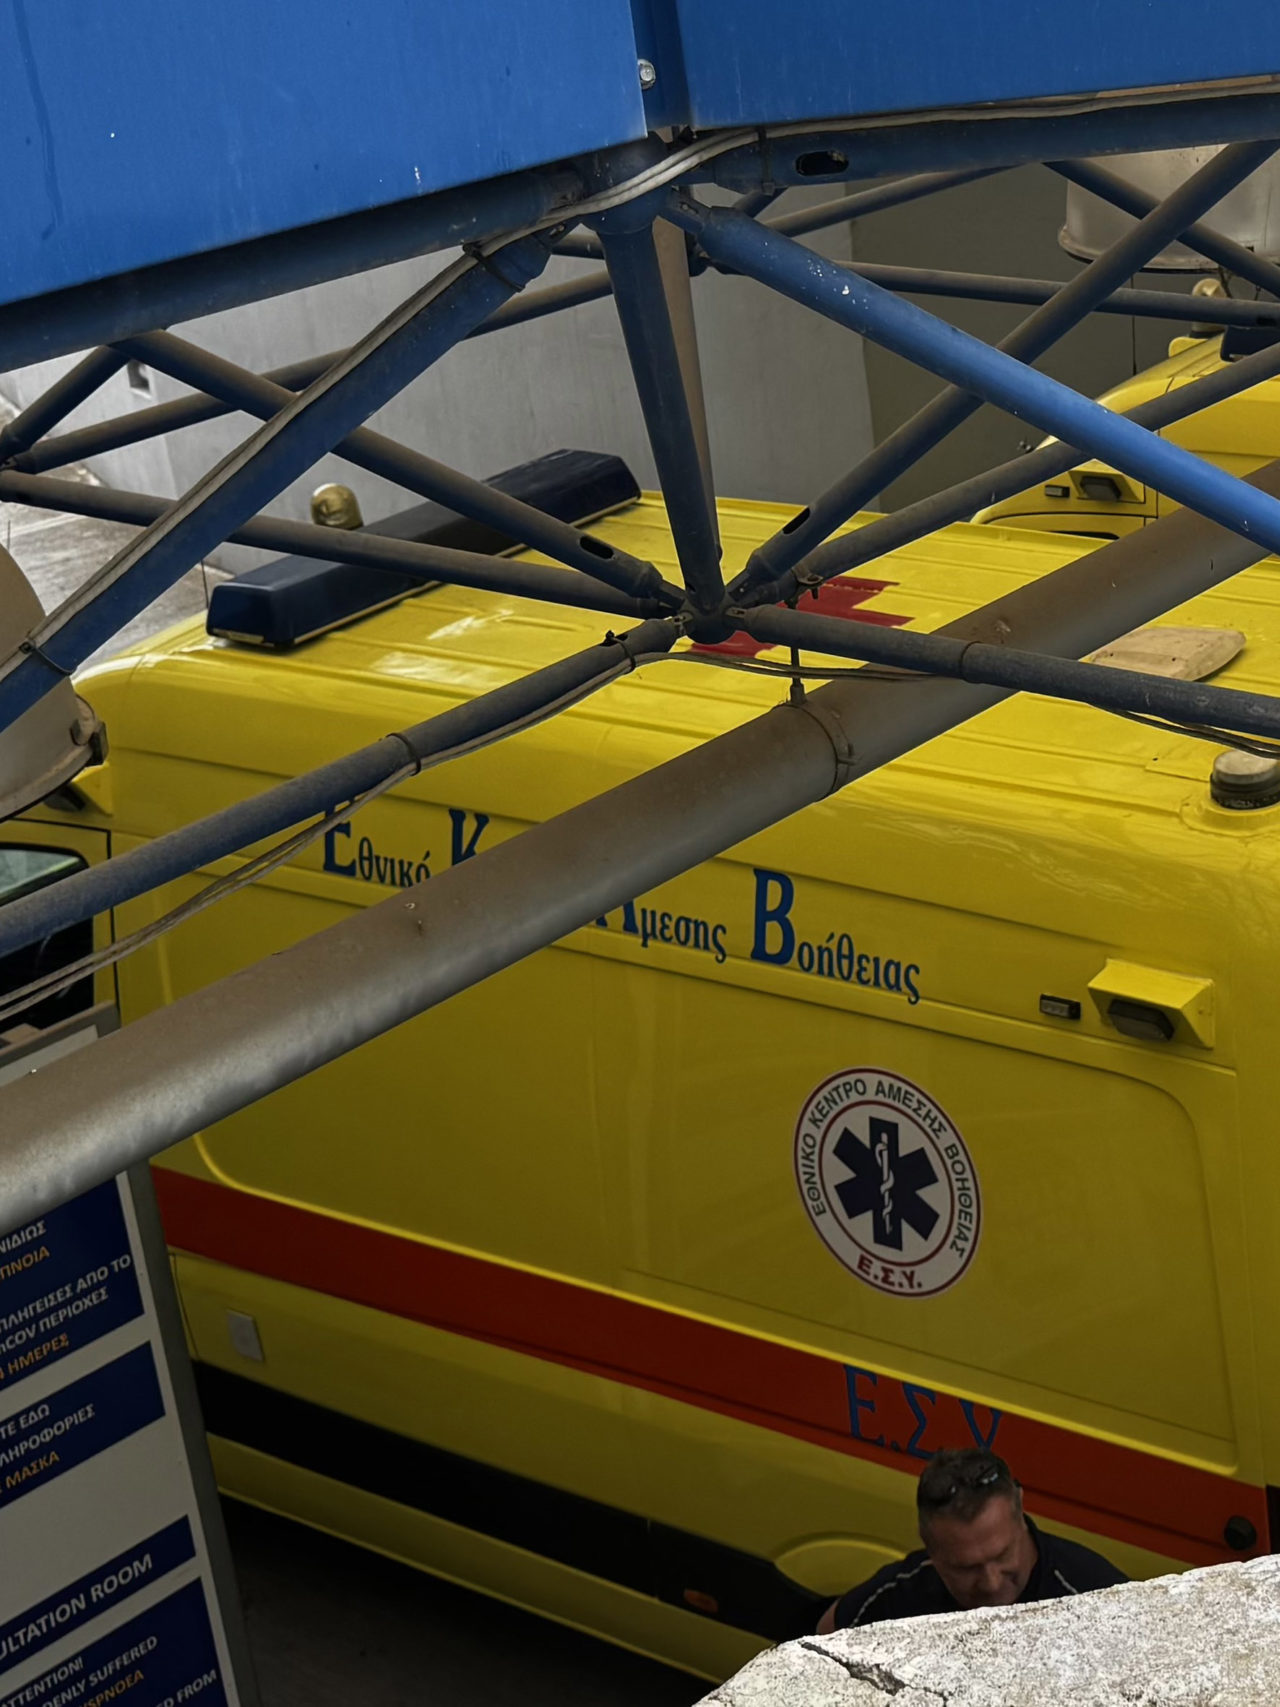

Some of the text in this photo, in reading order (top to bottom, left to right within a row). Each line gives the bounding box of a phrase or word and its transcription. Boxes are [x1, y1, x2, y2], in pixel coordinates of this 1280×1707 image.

[595, 867, 921, 1005] μεσης Βοήθειας
[801, 1077, 974, 1260] ΕΘΝΙΚΟ ΚΕΝΤΡΟ ΑΜΕΣΗΣ ΒΟΗΘΕΙΑΣ
[76, 1266, 109, 1294] ΑΠΟ
[110, 1254, 132, 1274] ΤΟ
[856, 1253, 923, 1290] Ε.Σ.Υ.
[38, 1286, 109, 1333] ΠΕΡΙΟΧΕΣ
[7, 1332, 70, 1376] ΗΜΕΡΕΣ
[19, 1403, 50, 1429] ΕΔΩ
[5, 1450, 61, 1489] ΜΑΣΚΑ
[90, 1552, 153, 1603] ROOM
[88, 1636, 159, 1687] SUFFERED
[79, 1669, 145, 1707] SPNOEA
[175, 1669, 218, 1704] FROM
